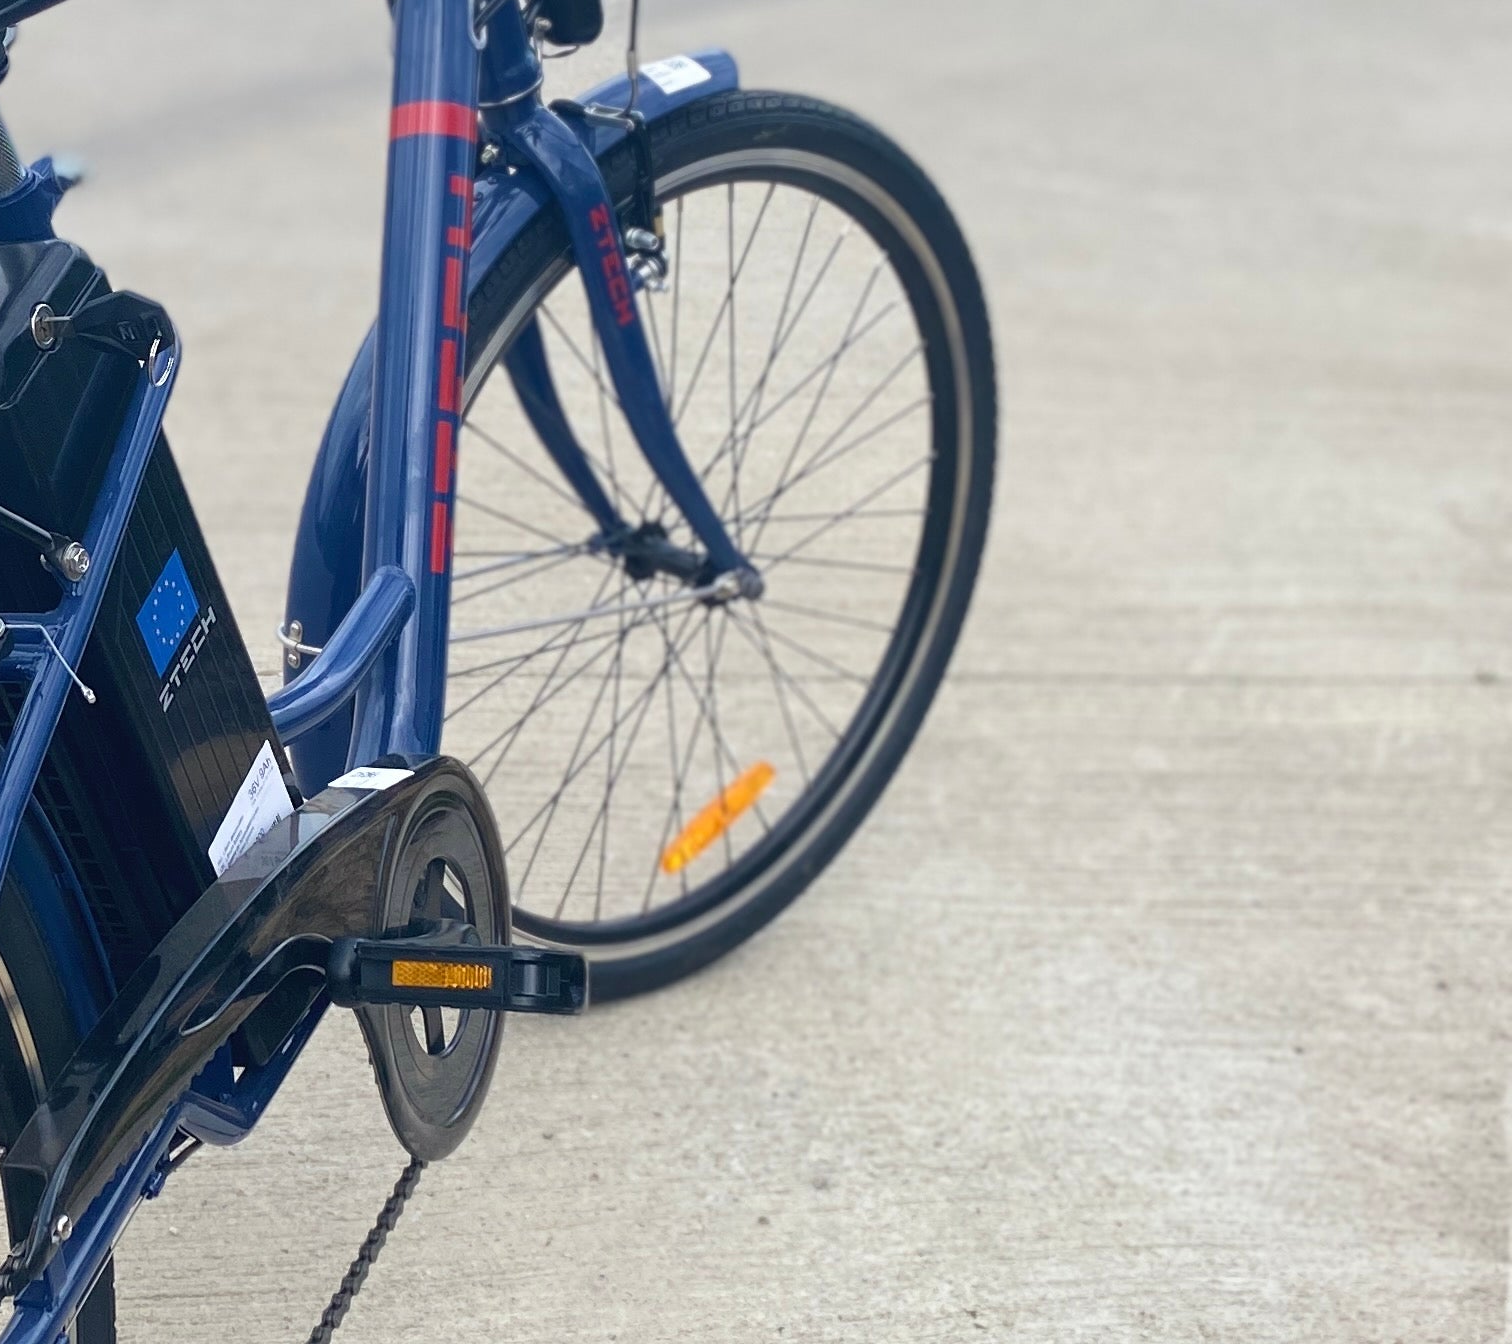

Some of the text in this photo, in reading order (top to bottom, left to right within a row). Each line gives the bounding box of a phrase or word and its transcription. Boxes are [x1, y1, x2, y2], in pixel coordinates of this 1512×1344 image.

[590, 203, 634, 326] ZTECH
[159, 606, 216, 712] ZTECH
[248, 775, 260, 800] 36V
